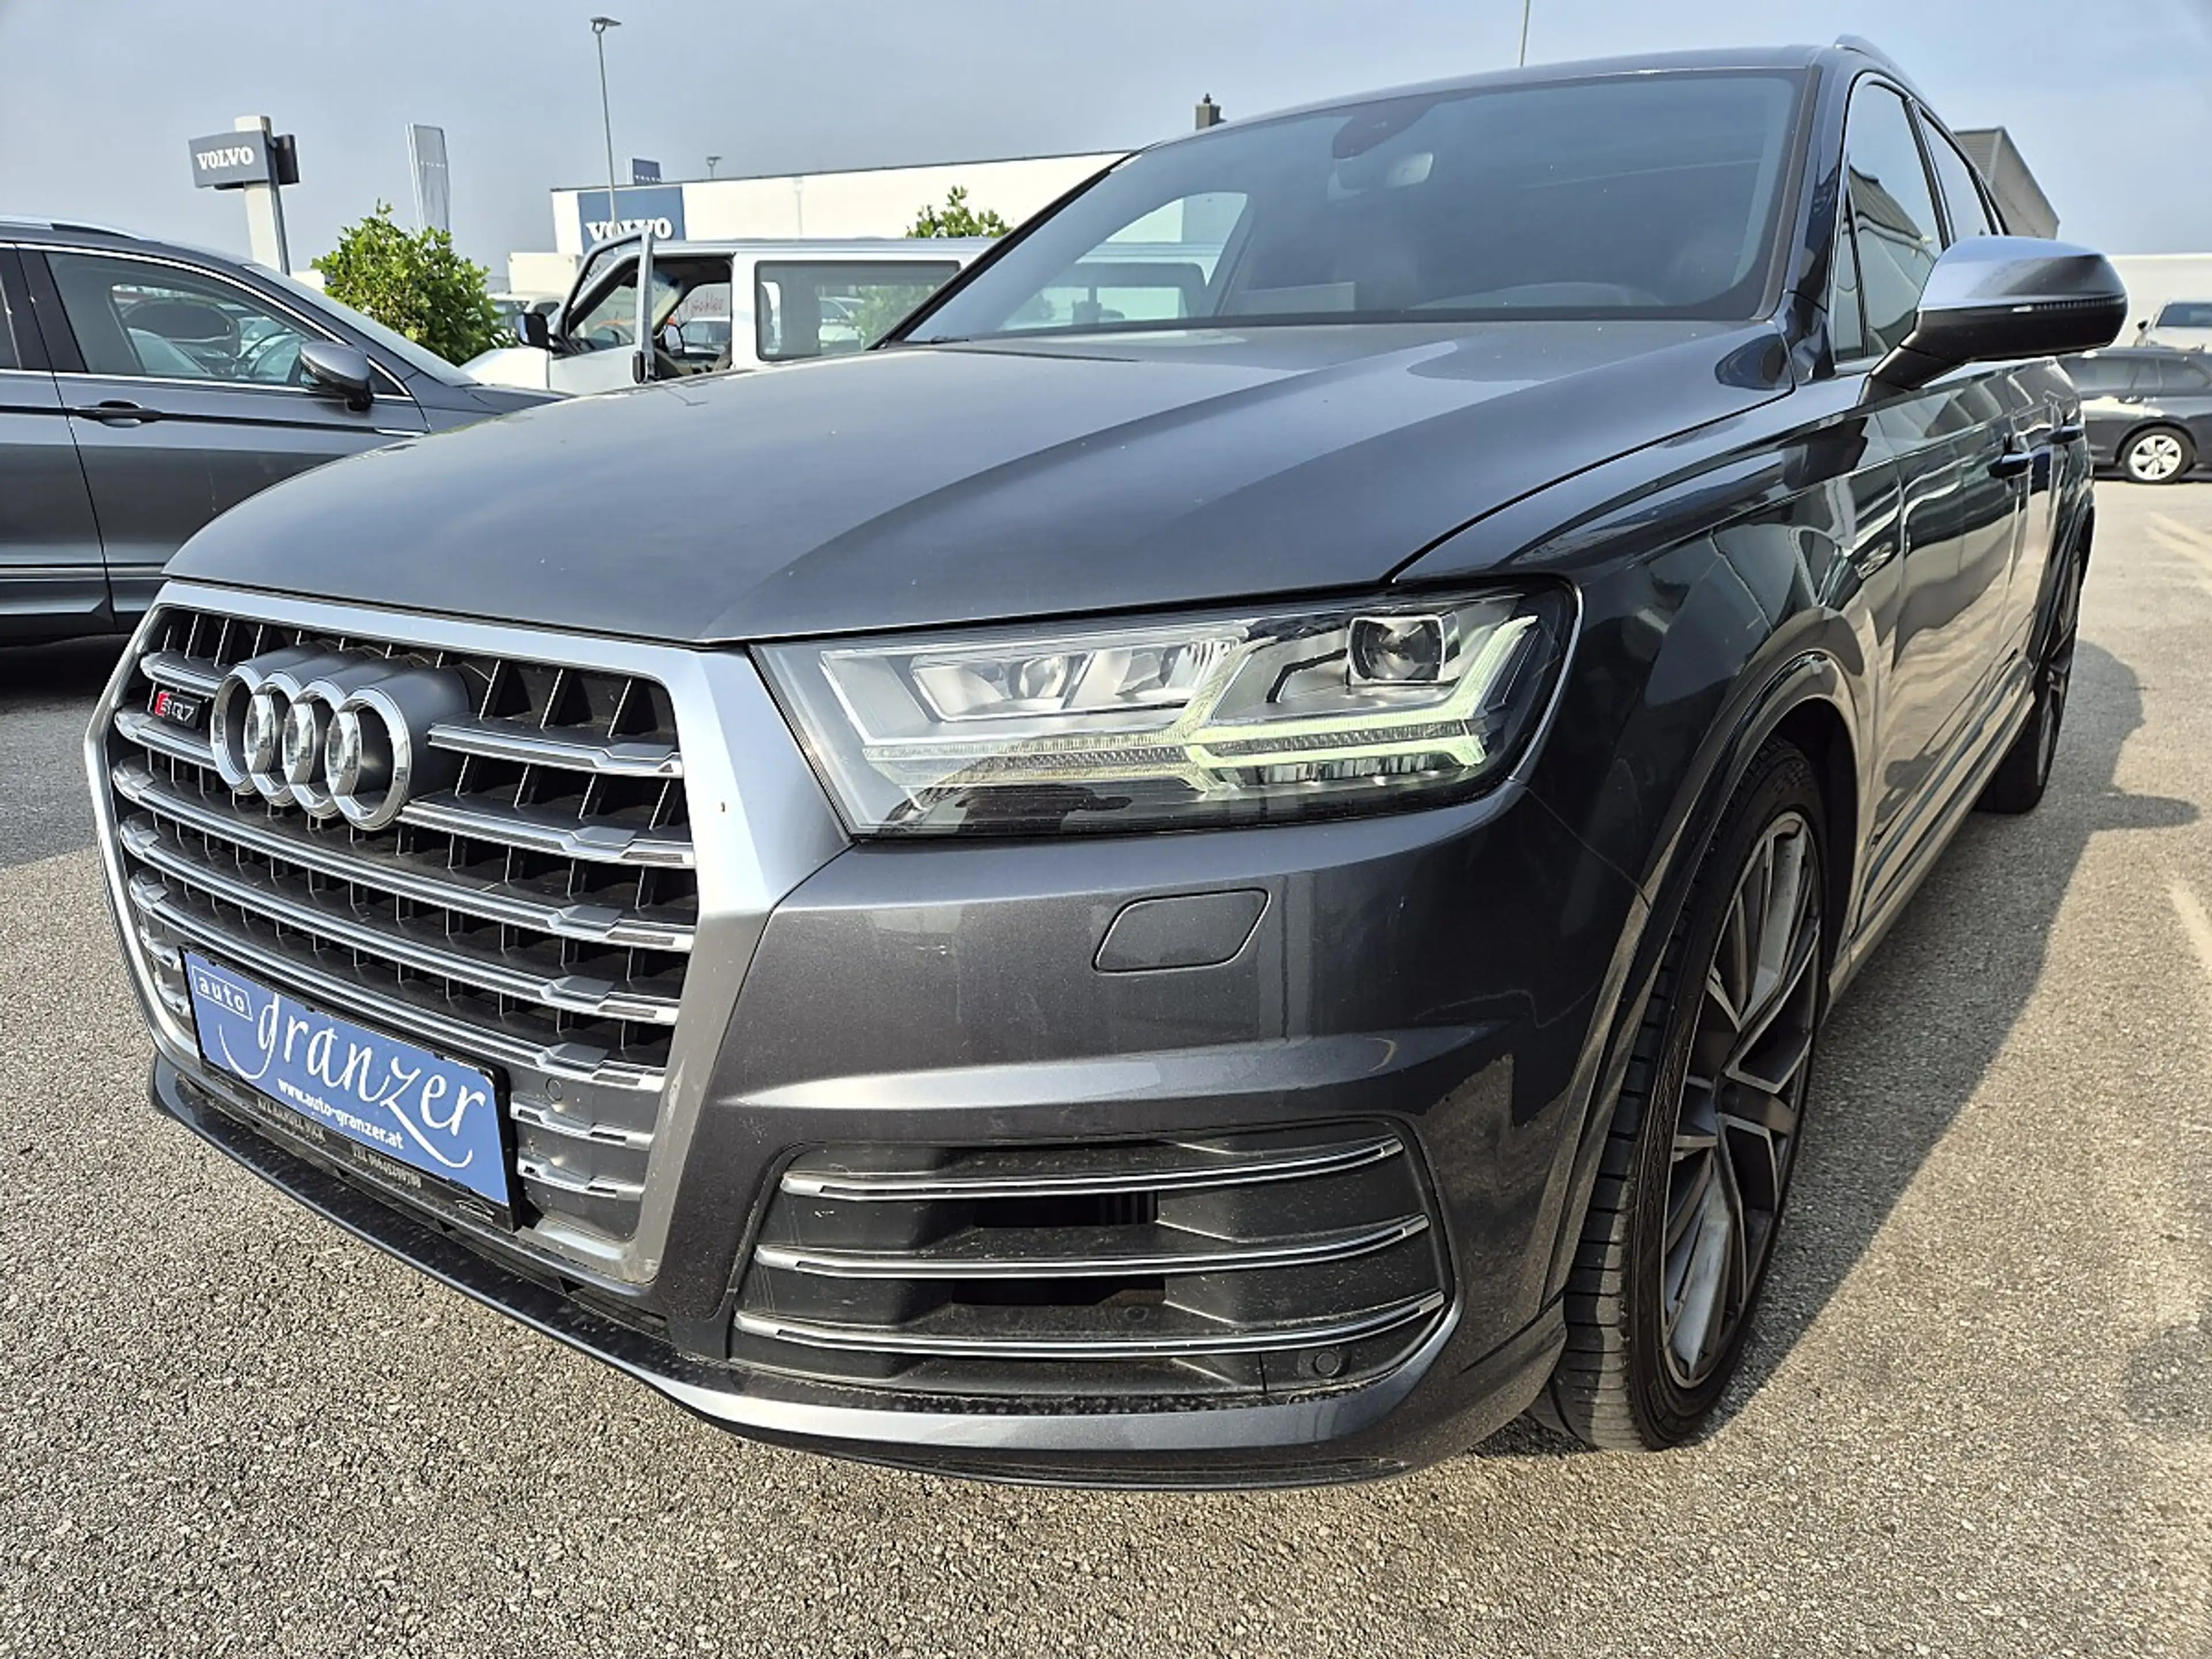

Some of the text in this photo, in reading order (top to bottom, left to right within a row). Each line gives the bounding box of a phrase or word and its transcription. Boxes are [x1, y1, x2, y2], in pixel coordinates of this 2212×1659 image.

[196, 146, 254, 171] VOLVO
[157, 695, 194, 721] SQ7
[199, 976, 245, 1012] auto
[218, 991, 486, 1168] granzer
[276, 1078, 405, 1150] www.auto-granzer.at
